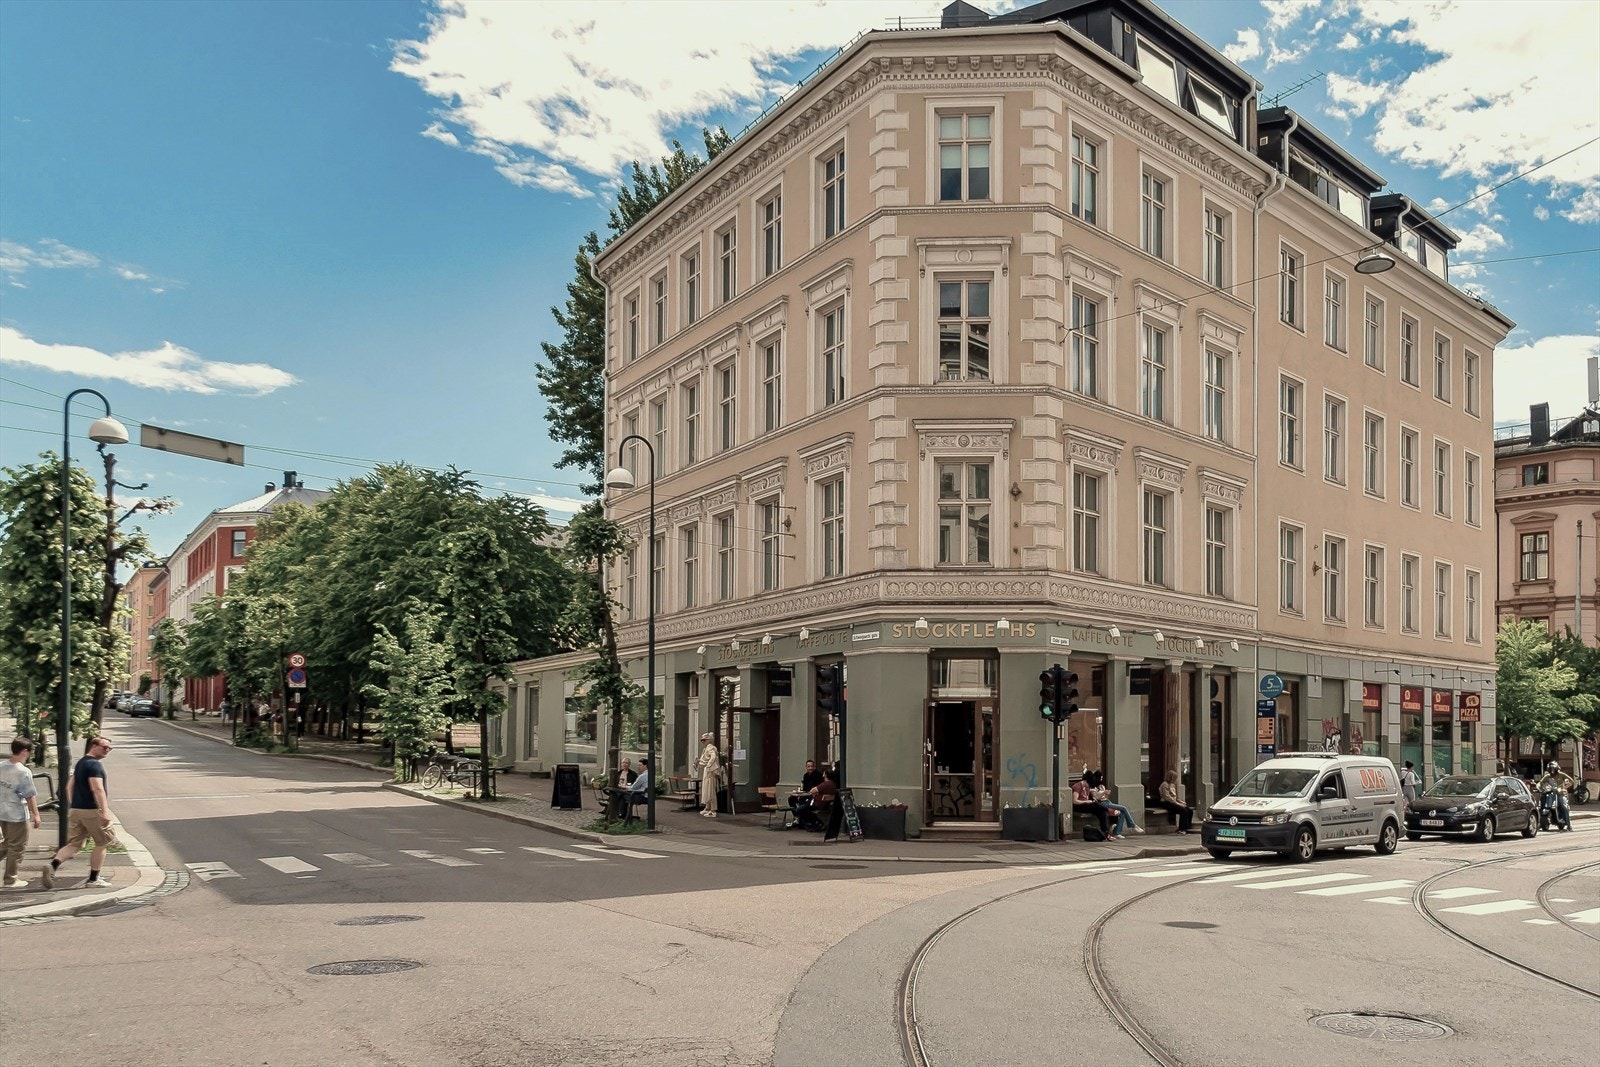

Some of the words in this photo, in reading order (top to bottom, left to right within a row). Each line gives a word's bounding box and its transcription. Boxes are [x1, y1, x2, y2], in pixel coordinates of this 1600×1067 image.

[822, 632, 835, 645] OG
[1071, 629, 1101, 644] KAFFE
[1122, 635, 1133, 647] TE
[293, 657, 303, 665] 30
[1266, 678, 1274, 689] 5
[1460, 708, 1478, 717] PIZZA
